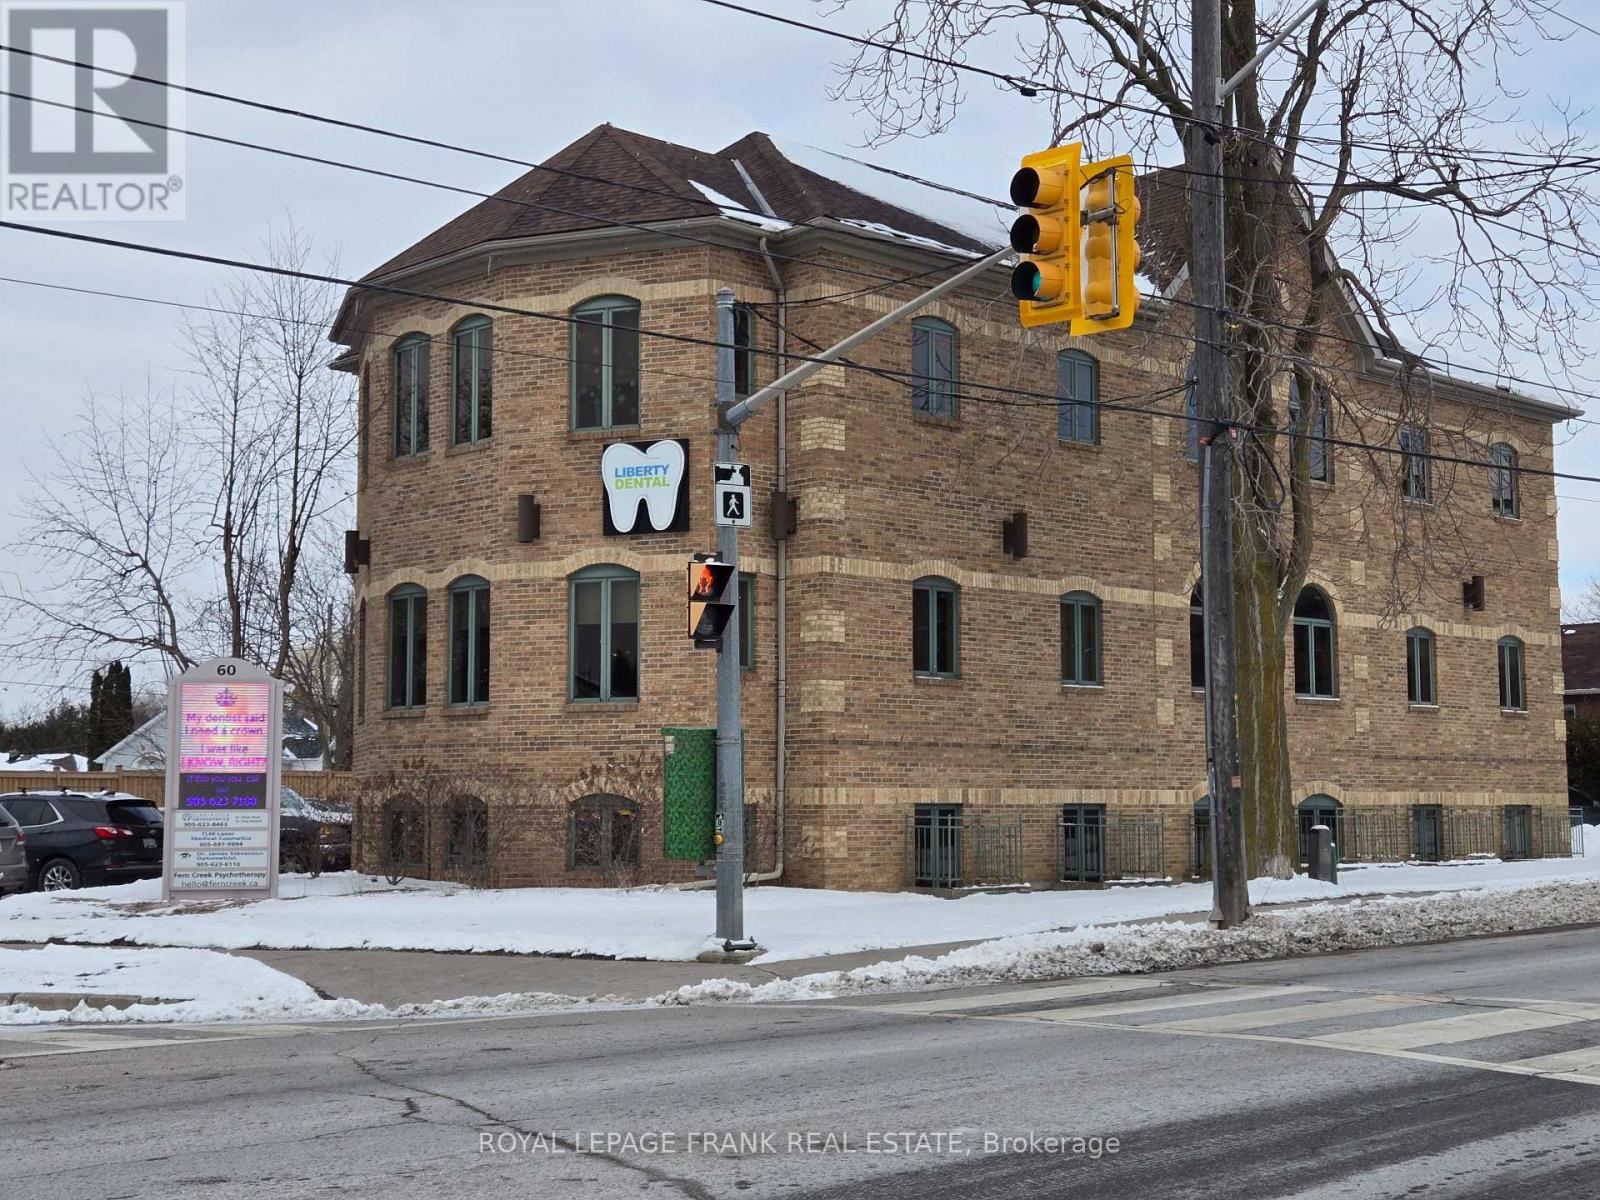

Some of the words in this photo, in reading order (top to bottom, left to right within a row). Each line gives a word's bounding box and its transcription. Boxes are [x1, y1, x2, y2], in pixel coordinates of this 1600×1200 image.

[615, 464, 669, 478] LIBERTY
[615, 476, 670, 490] DENTAL
[217, 664, 236, 676] 60
[187, 713, 202, 724] My
[245, 713, 265, 722] said
[231, 727, 264, 735] crown
[214, 871, 266, 879] Psychotherapy
[181, 880, 258, 888] hello@ferncreek.ca
